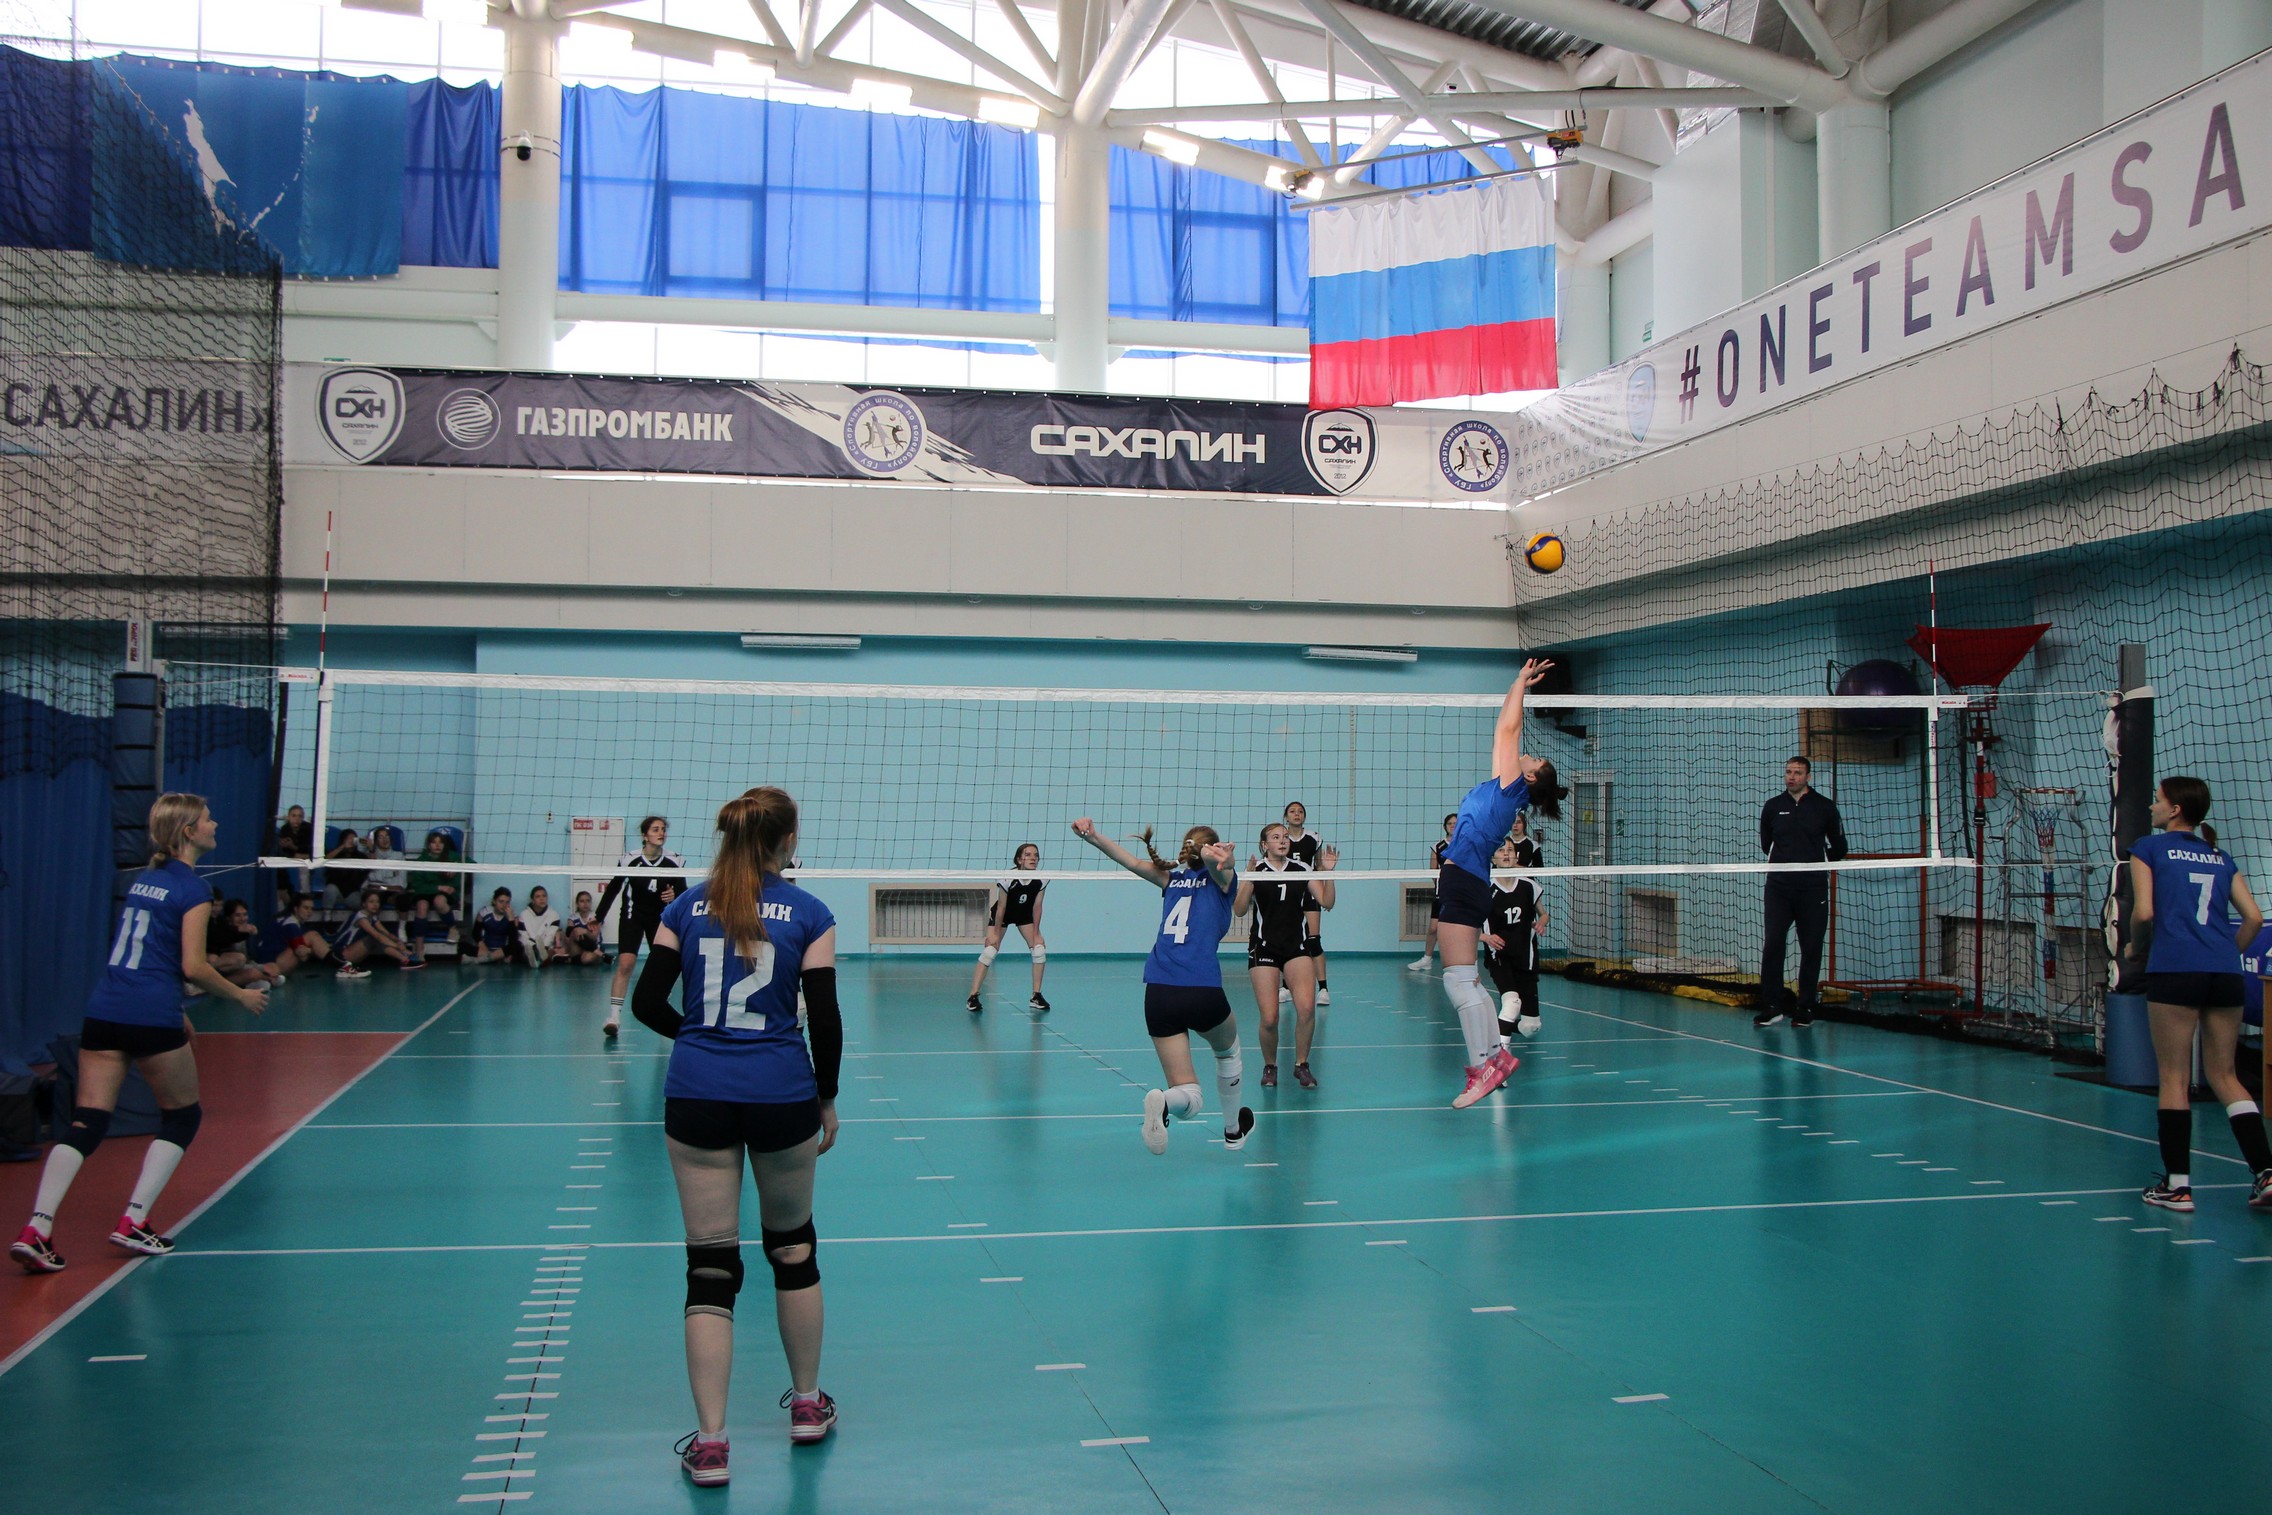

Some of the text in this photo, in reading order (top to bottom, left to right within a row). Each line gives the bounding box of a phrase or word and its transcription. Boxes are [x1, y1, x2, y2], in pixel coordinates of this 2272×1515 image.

[517, 406, 734, 442] ГАЗПРОМБАНК
[1030, 423, 1266, 464] САХАЛИН
[1318, 434, 1362, 455] СХН
[860, 459, 879, 470] ГБУ
[2167, 849, 2225, 866] САХАЛИН
[648, 878, 658, 893] 4
[1277, 883, 1287, 901] 7
[1018, 893, 1028, 904] 9
[2189, 872, 2215, 926] 7
[1163, 895, 1192, 944] 4
[1504, 906, 1522, 925] 12
[109, 907, 151, 970] 11
[698, 937, 776, 1031] 12
